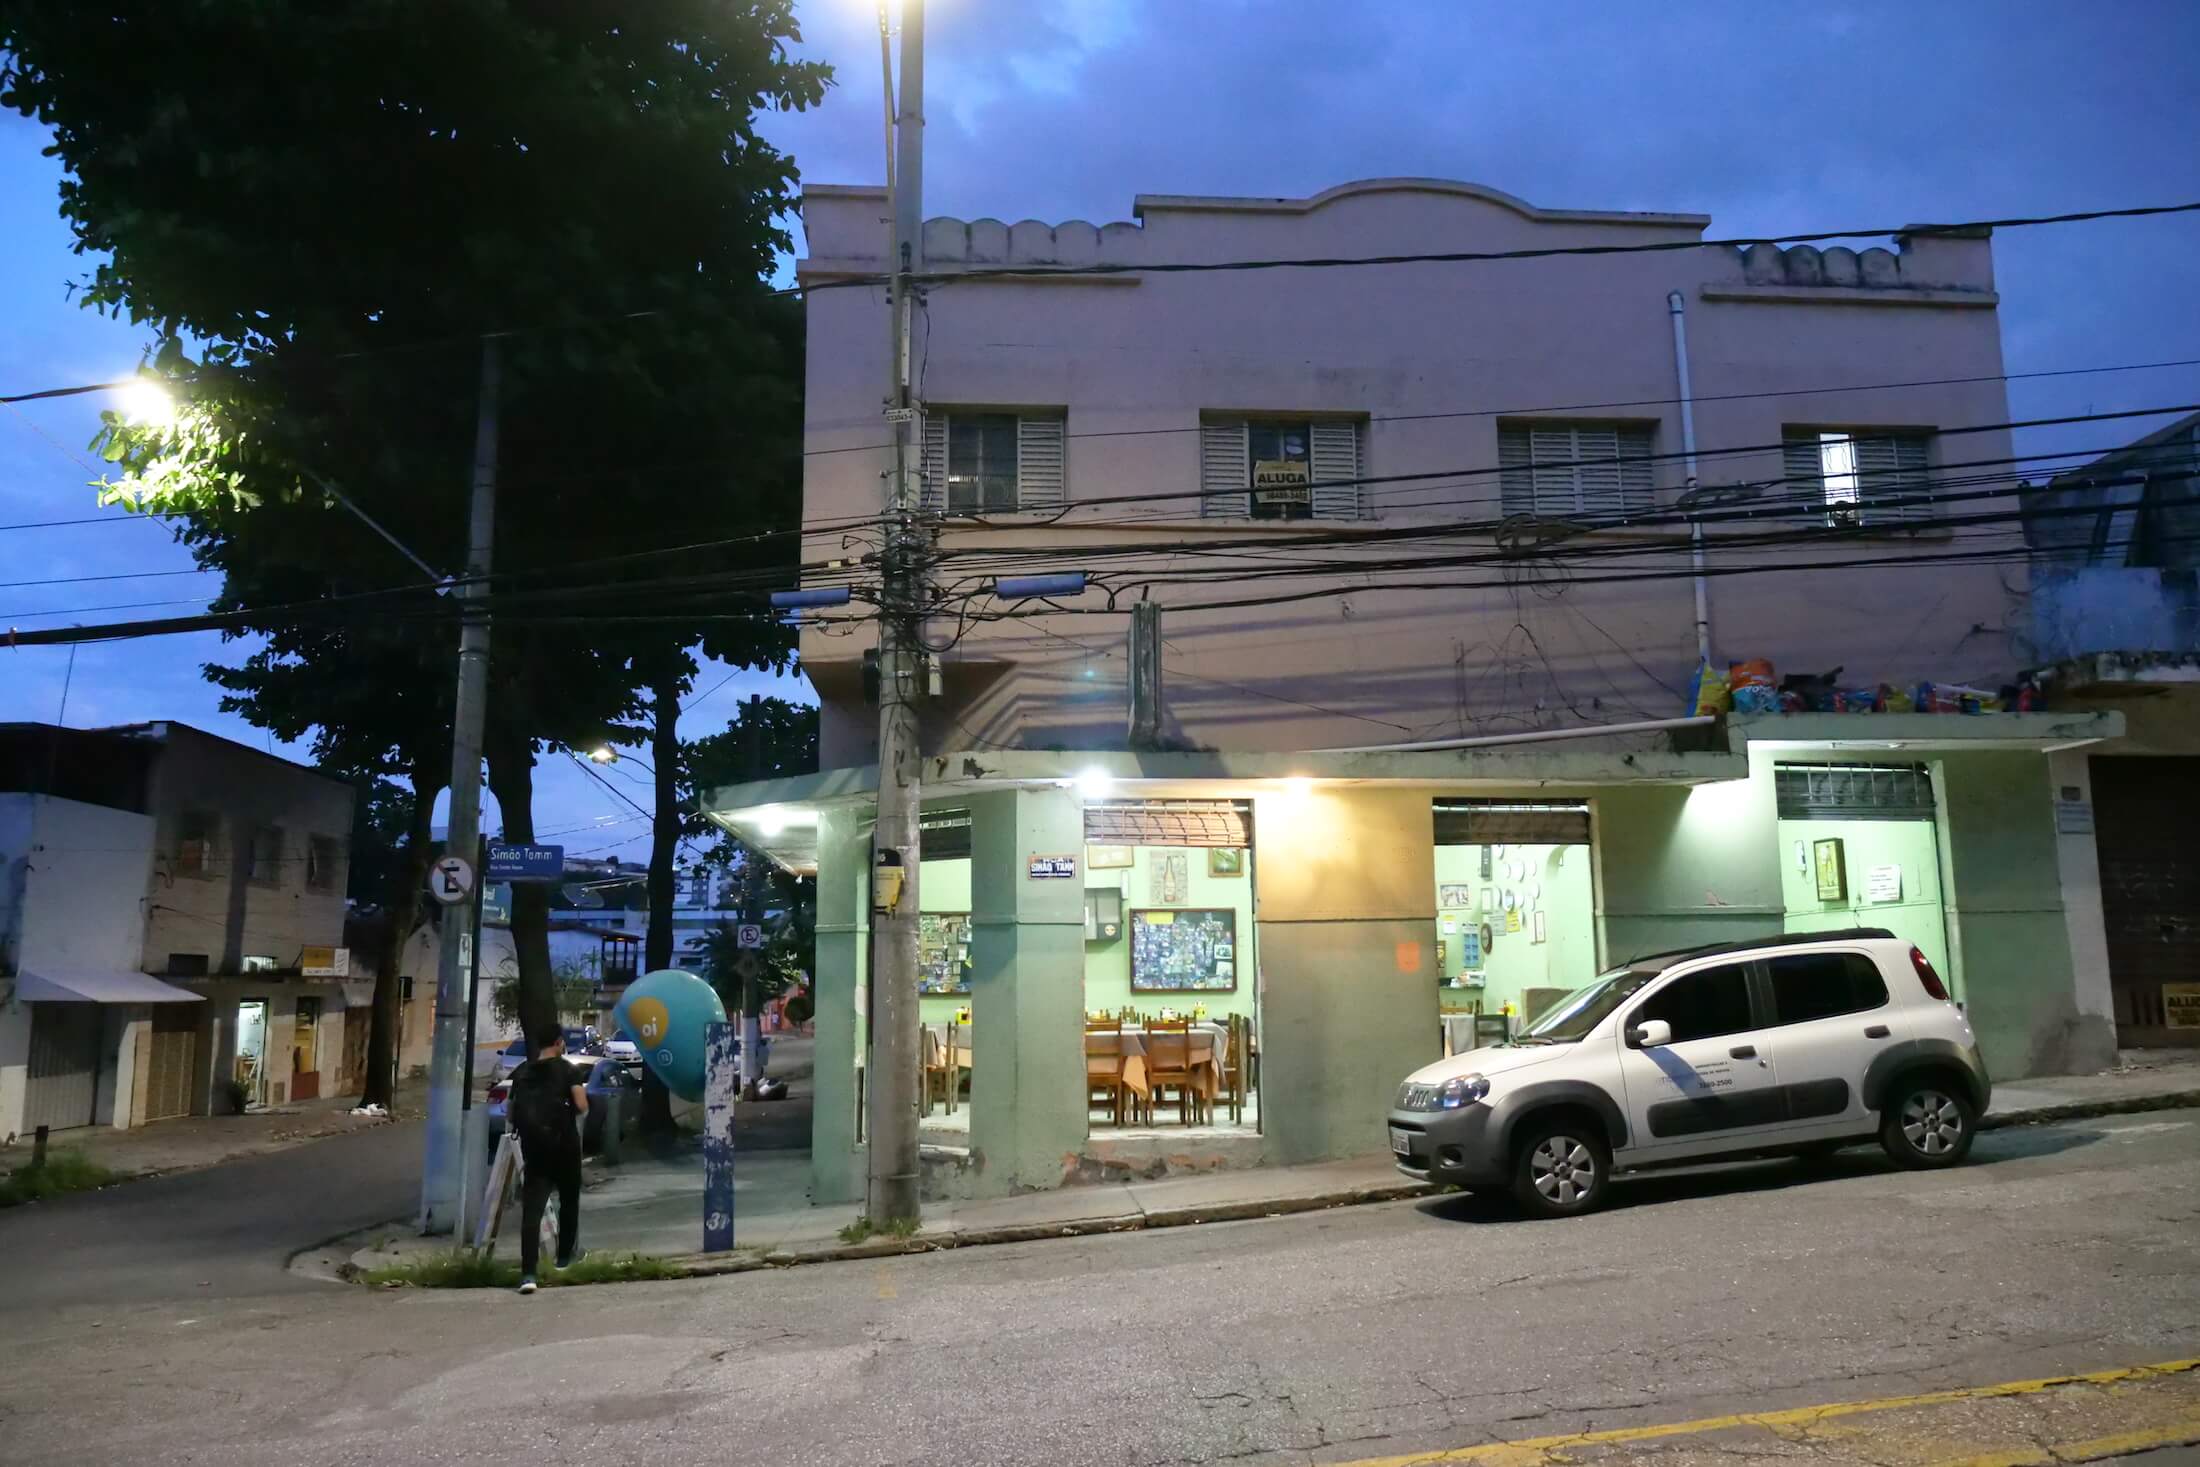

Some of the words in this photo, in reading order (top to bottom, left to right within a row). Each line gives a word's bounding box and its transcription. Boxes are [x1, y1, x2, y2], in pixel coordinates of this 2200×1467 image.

[1257, 473, 1306, 483] ALUGA
[491, 847, 521, 860] Simão
[524, 847, 553, 860] Tamm
[642, 1016, 657, 1037] oi
